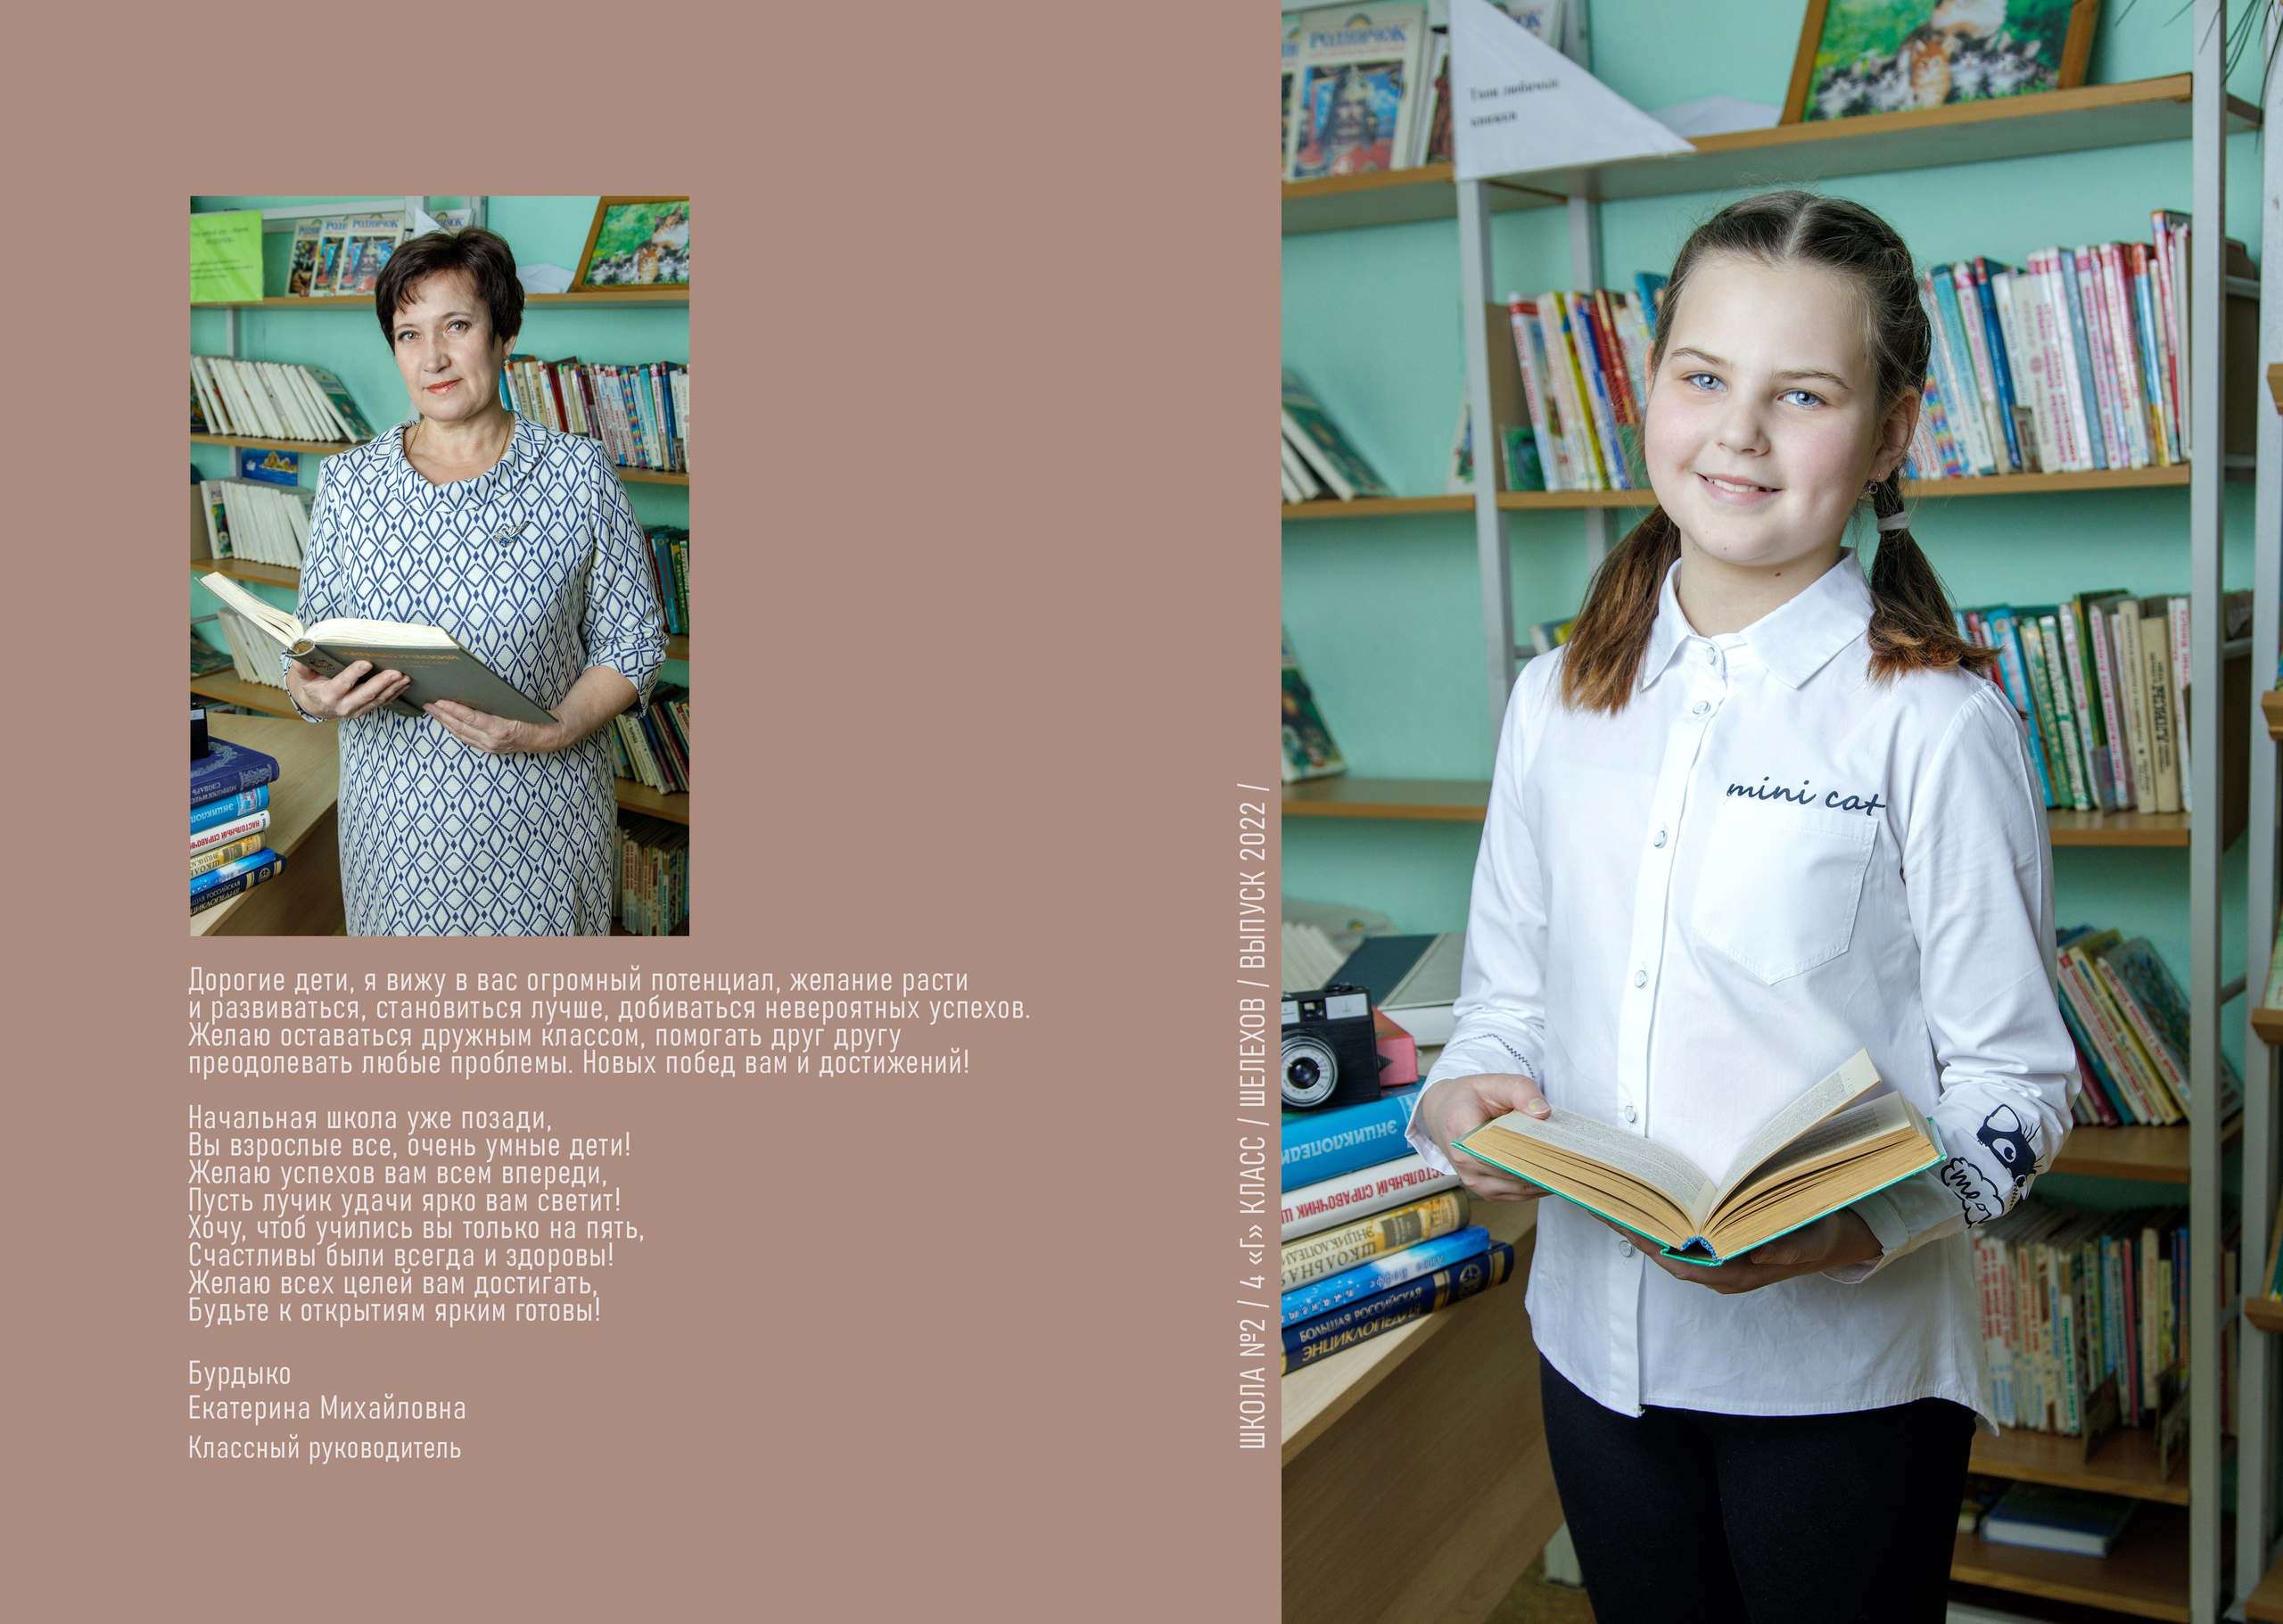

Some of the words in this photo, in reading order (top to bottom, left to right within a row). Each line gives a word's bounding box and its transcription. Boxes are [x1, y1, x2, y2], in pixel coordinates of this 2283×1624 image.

[1727, 777, 1817, 804] mini
[1826, 790, 1886, 816] cat
[221, 820, 260, 840] НАСТОЛЬНЫЙ
[206, 880, 241, 899] РОССИЙСКАЯ
[1377, 1167, 1446, 1197] СТОЛЬНЫЙ
[1298, 1184, 1373, 1219] СПРАВОЧНИК
[1369, 1267, 1408, 1289] Иоффе
[1415, 1255, 1444, 1271] Анна
[1298, 1313, 1352, 1343] БОЛЬШАЯ
[1354, 1287, 1423, 1322] РОССИЙСКАЯ
[1302, 1302, 1422, 1363] ЭНЦИКЛОПЕДИЯ
